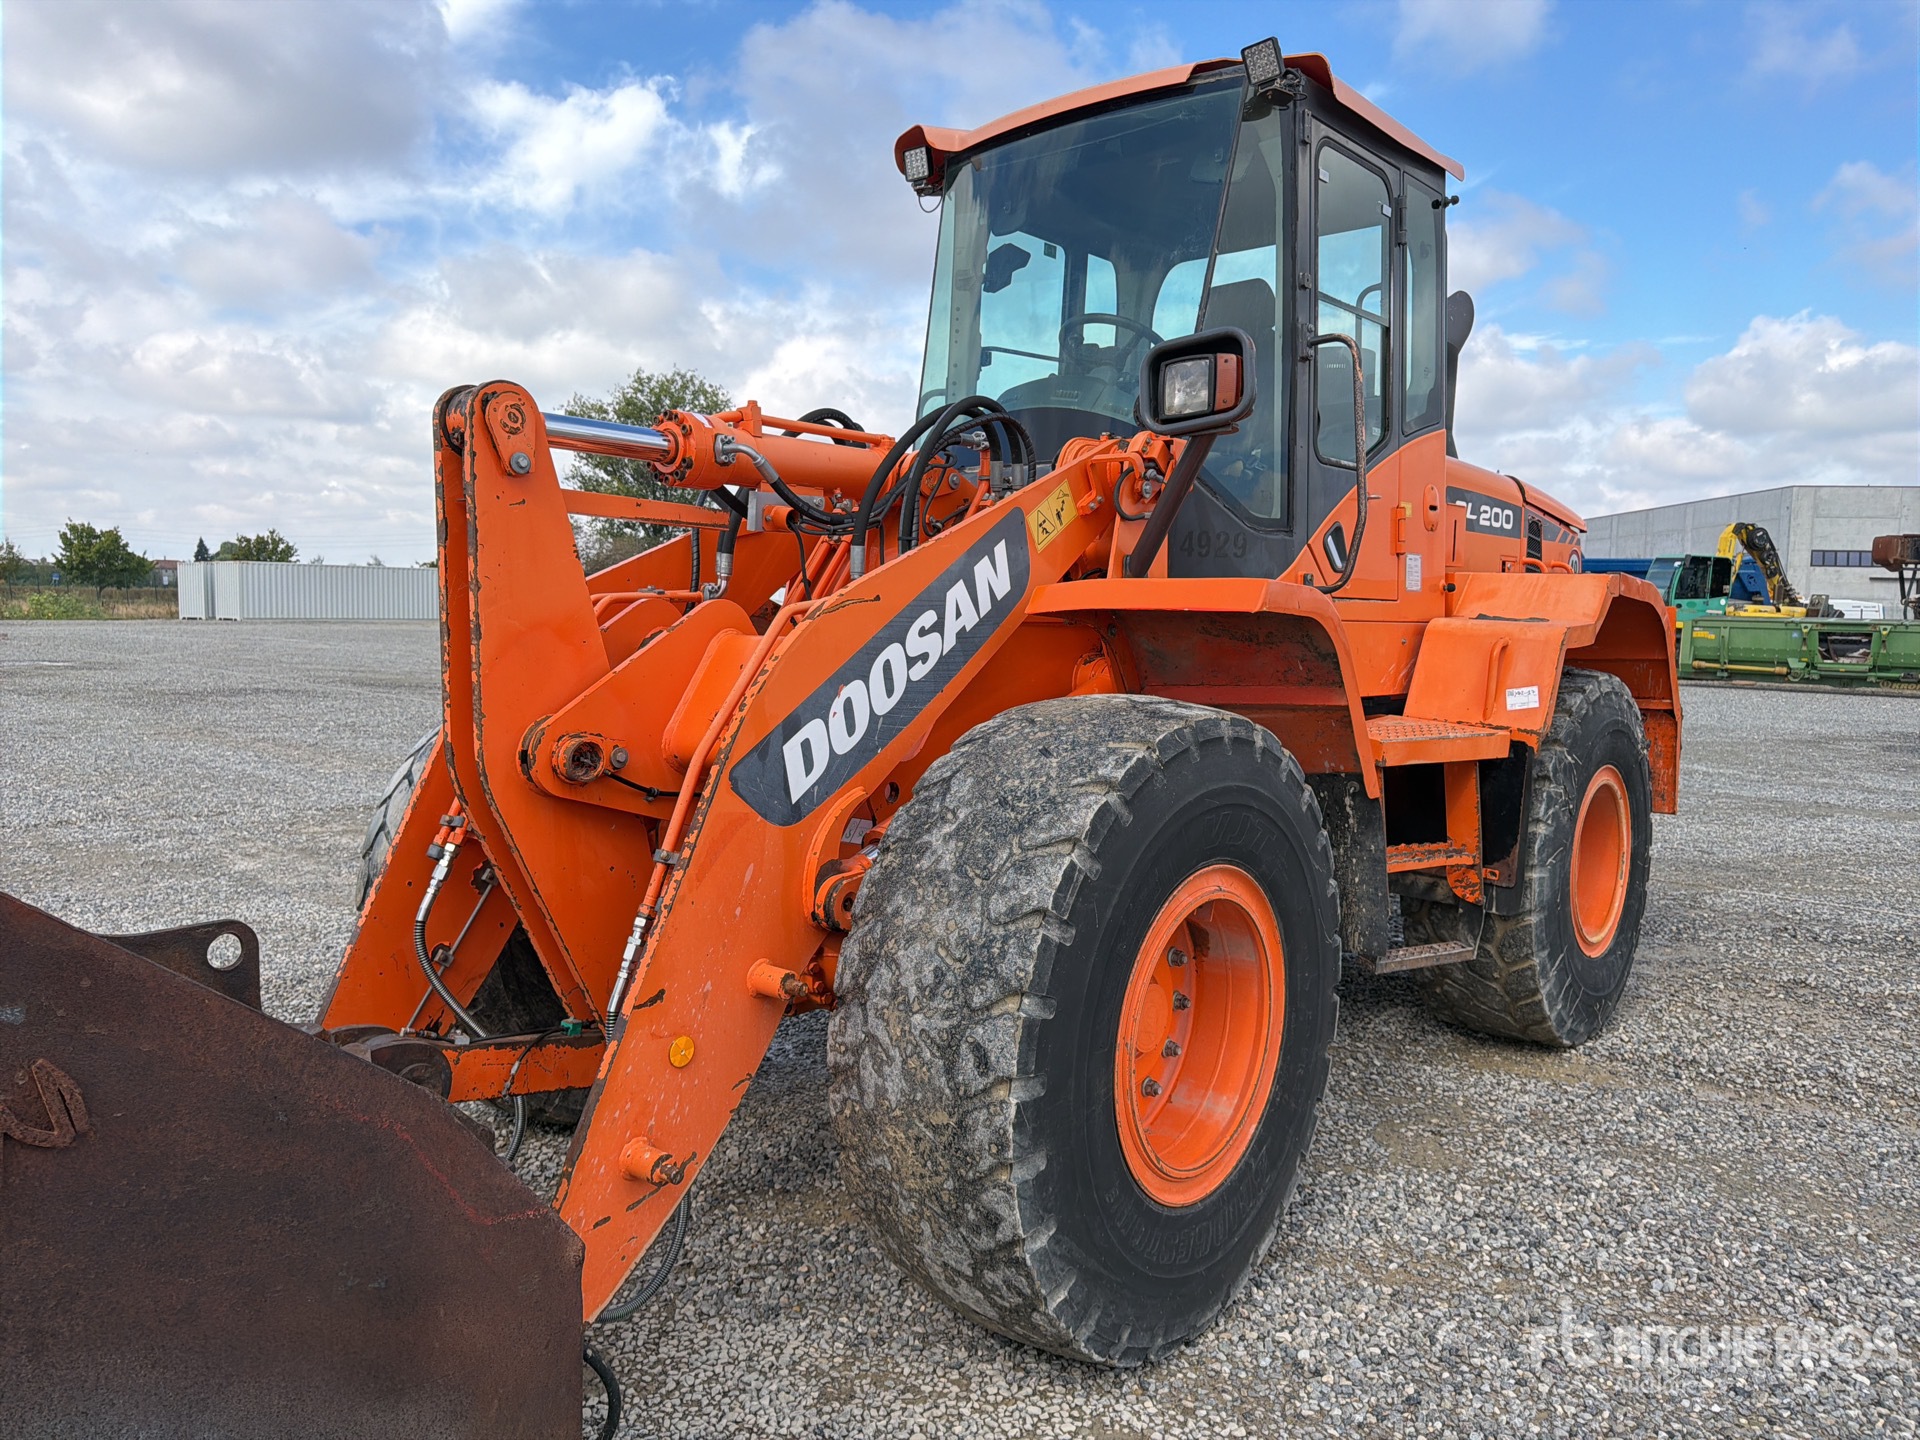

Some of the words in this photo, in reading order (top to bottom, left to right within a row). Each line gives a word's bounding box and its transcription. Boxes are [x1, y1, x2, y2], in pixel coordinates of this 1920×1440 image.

[1455, 499, 1514, 530] L200
[1180, 530, 1248, 559] 4929
[782, 537, 1012, 805] DOOSAN
